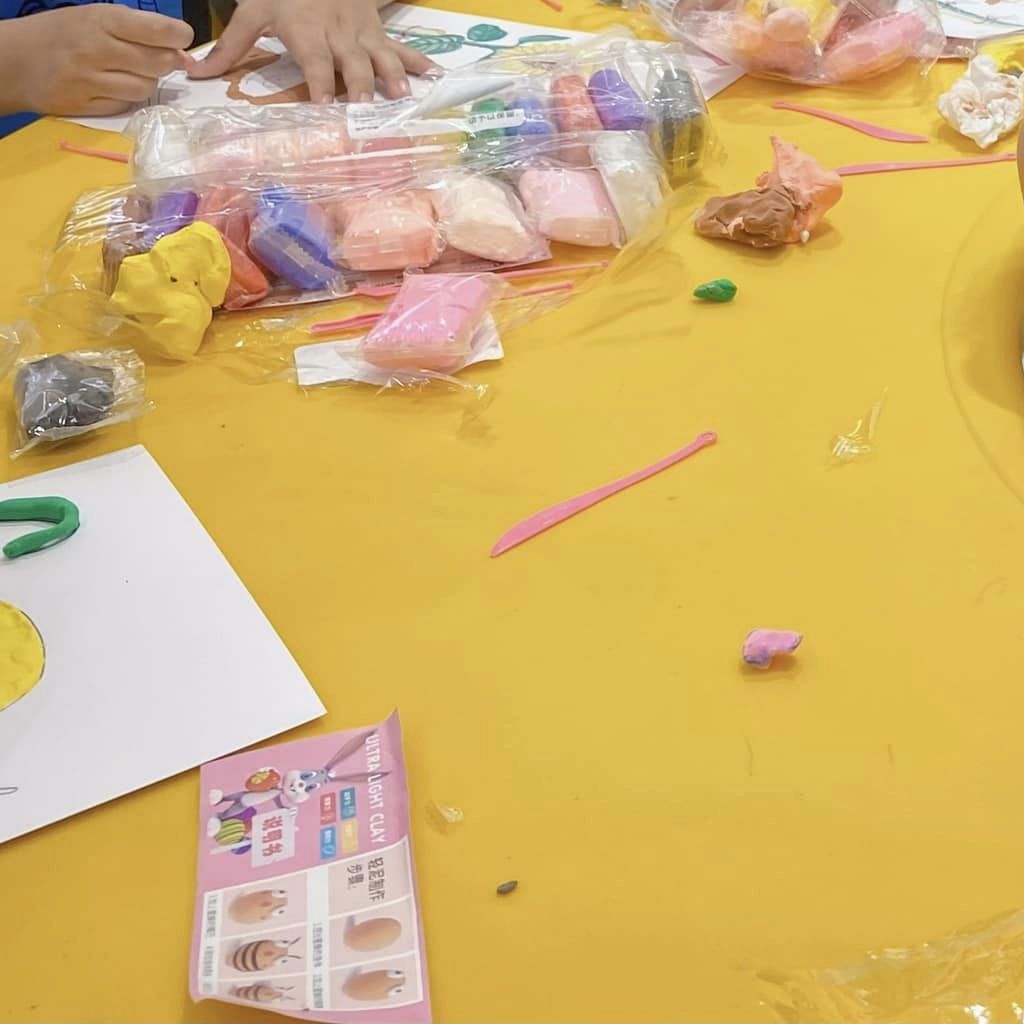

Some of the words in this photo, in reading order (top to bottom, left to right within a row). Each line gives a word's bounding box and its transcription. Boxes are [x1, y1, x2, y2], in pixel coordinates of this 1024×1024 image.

[365, 733, 381, 773] ULTRA
[368, 774, 384, 809] LIGHT
[261, 815, 284, 857] 说明书
[369, 812, 387, 843] CLAY
